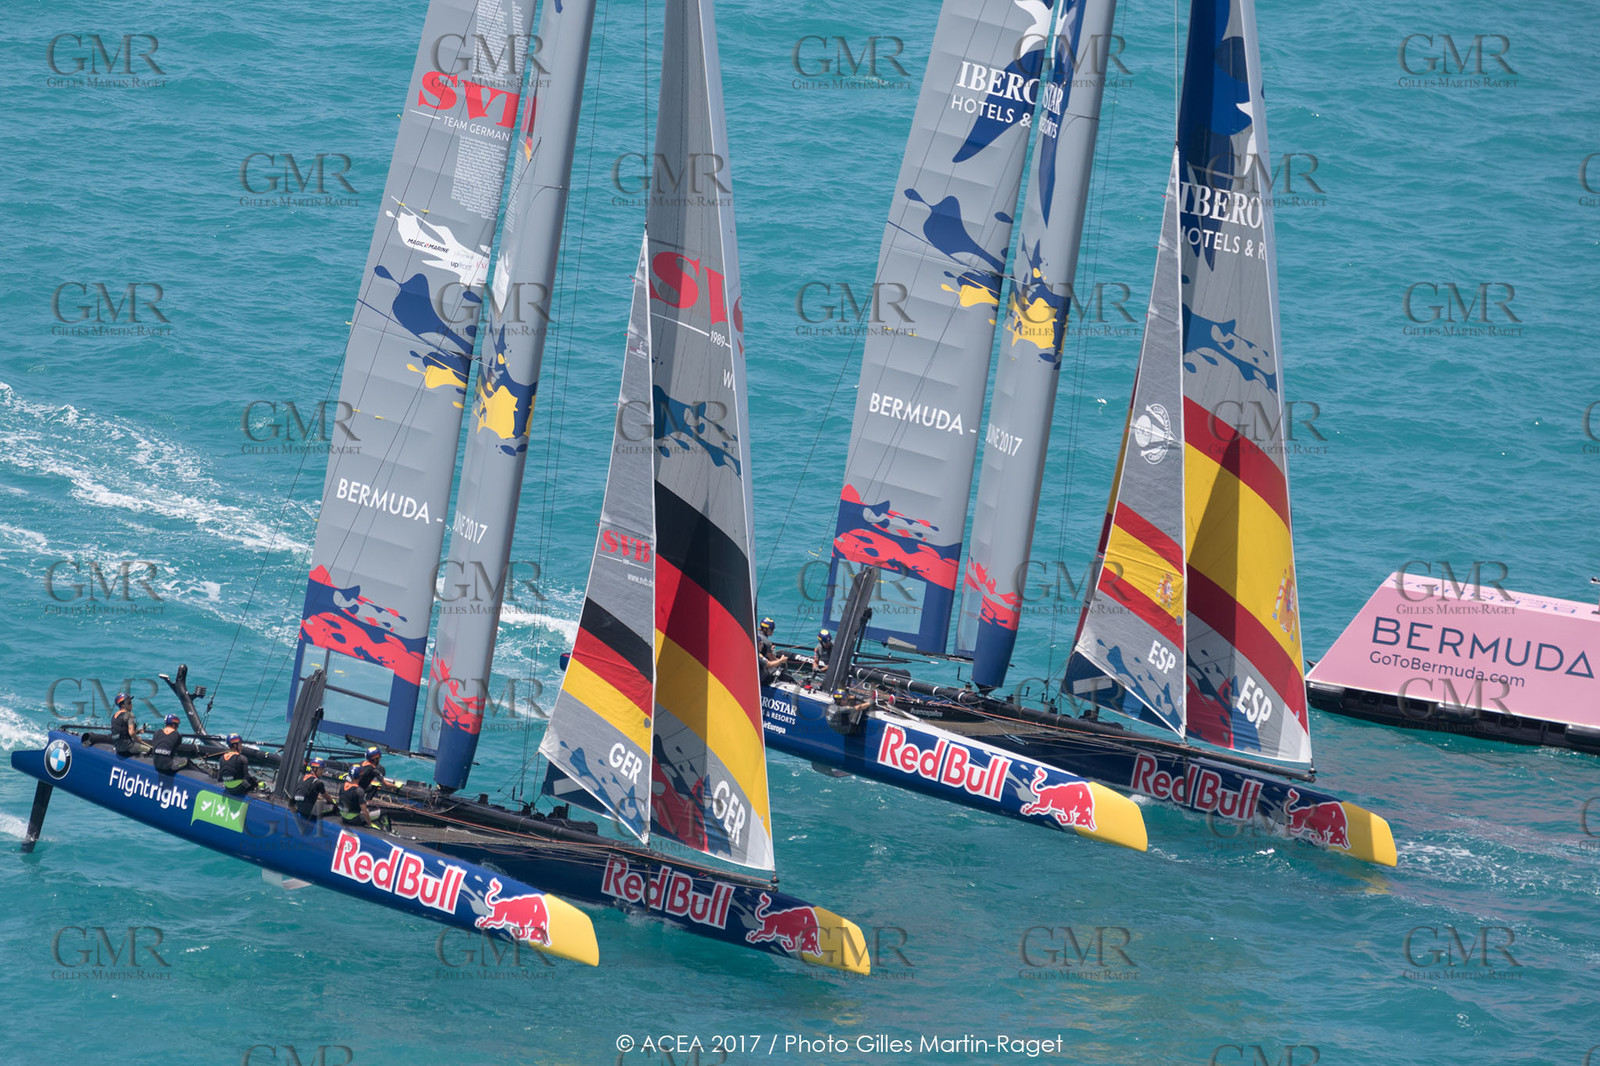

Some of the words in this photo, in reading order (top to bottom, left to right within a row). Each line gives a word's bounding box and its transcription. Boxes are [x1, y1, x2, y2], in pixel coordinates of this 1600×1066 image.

[443, 115, 468, 131] TEAM
[469, 123, 513, 142] GERMAN
[951, 94, 1015, 124] HOTELS
[1020, 112, 1031, 128] &
[407, 238, 425, 247] MAGIC
[429, 243, 450, 254] MARINE
[1244, 239, 1254, 258] &
[710, 330, 726, 347] 1989
[869, 392, 964, 435] BERMUDA
[999, 431, 1023, 457] 2017
[336, 478, 430, 524] BERMUDA
[465, 519, 488, 544] 2017
[601, 530, 651, 563] SVB
[1147, 639, 1176, 675] ESP
[1372, 616, 1595, 679] BERMUDA
[1369, 651, 1525, 688] GoToBermuda.com
[761, 695, 798, 716] ROSTAR
[771, 712, 796, 725] RESORTS
[1236, 675, 1273, 730] ESP
[49, 742, 72, 758] BMW
[608, 742, 643, 785] GER
[877, 723, 949, 781] Red
[941, 744, 1012, 802] Bull
[109, 766, 189, 810] Flightright
[712, 780, 746, 847] GER
[331, 829, 403, 892] Red
[395, 852, 467, 914] Bull
